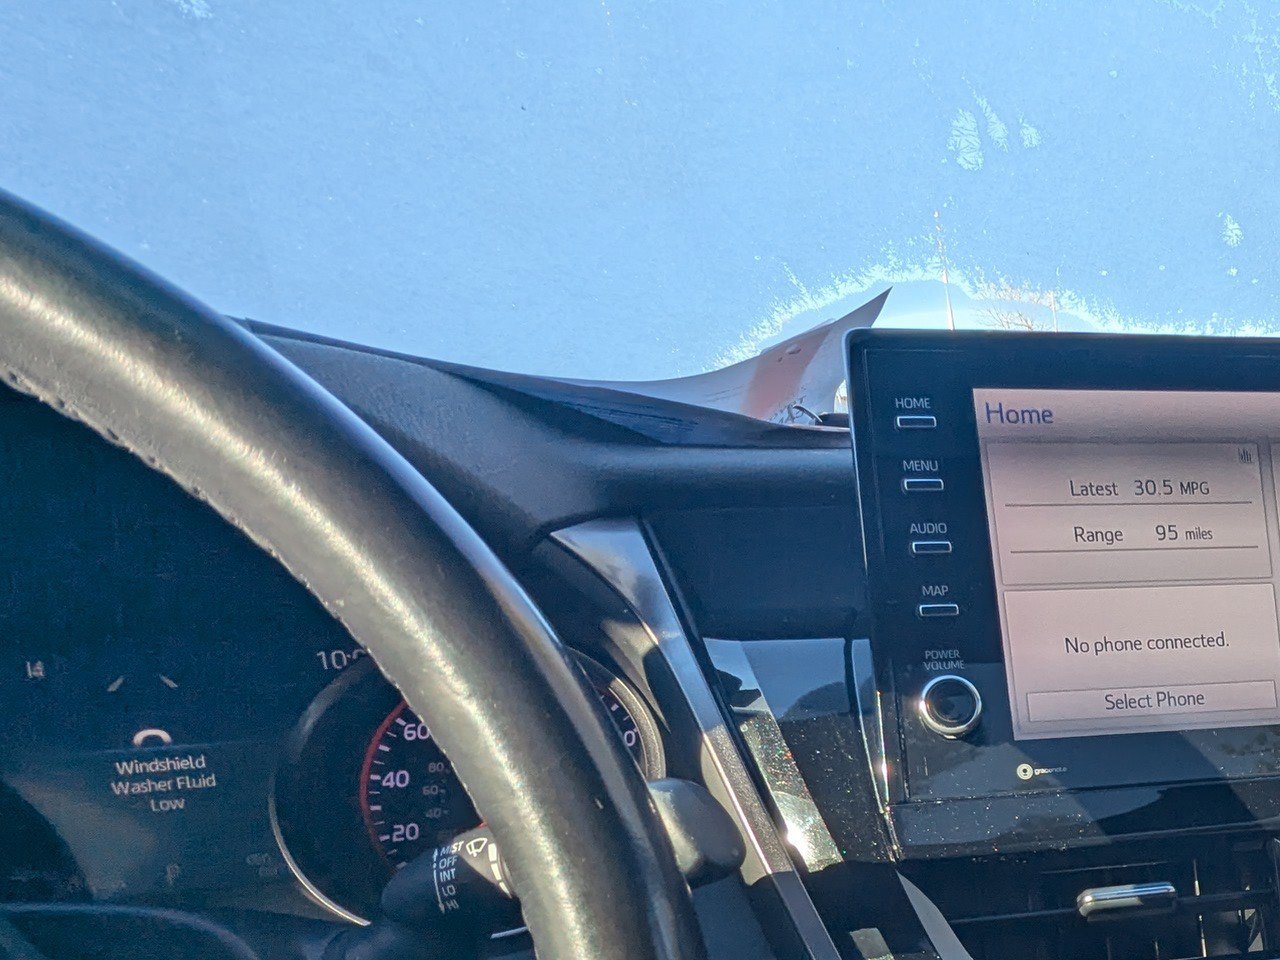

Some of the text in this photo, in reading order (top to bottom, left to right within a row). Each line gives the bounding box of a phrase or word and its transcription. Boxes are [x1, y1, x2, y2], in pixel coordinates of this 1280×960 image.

[895, 398, 931, 409] HOME
[985, 402, 1054, 425] Home
[903, 460, 939, 472] MENU
[1069, 479, 1210, 498] Latest 30.5 MPG
[910, 522, 947, 534] AUDIO
[1073, 525, 1213, 546] Range 95 miles
[922, 585, 949, 597] MAP
[1064, 631, 1230, 657] No phone connected.
[924, 649, 961, 660] POWER
[923, 659, 966, 671] VOLUME
[1104, 691, 1205, 710] Select Phone
[404, 723, 430, 741] 60
[115, 753, 207, 776] Windshield
[110, 773, 216, 796] Washer Fluid
[382, 769, 410, 788] 40
[150, 797, 185, 812] Low
[392, 822, 420, 842] 20
[439, 855, 458, 870] OFF
[440, 868, 456, 882] INT
[441, 884, 456, 897] LO
